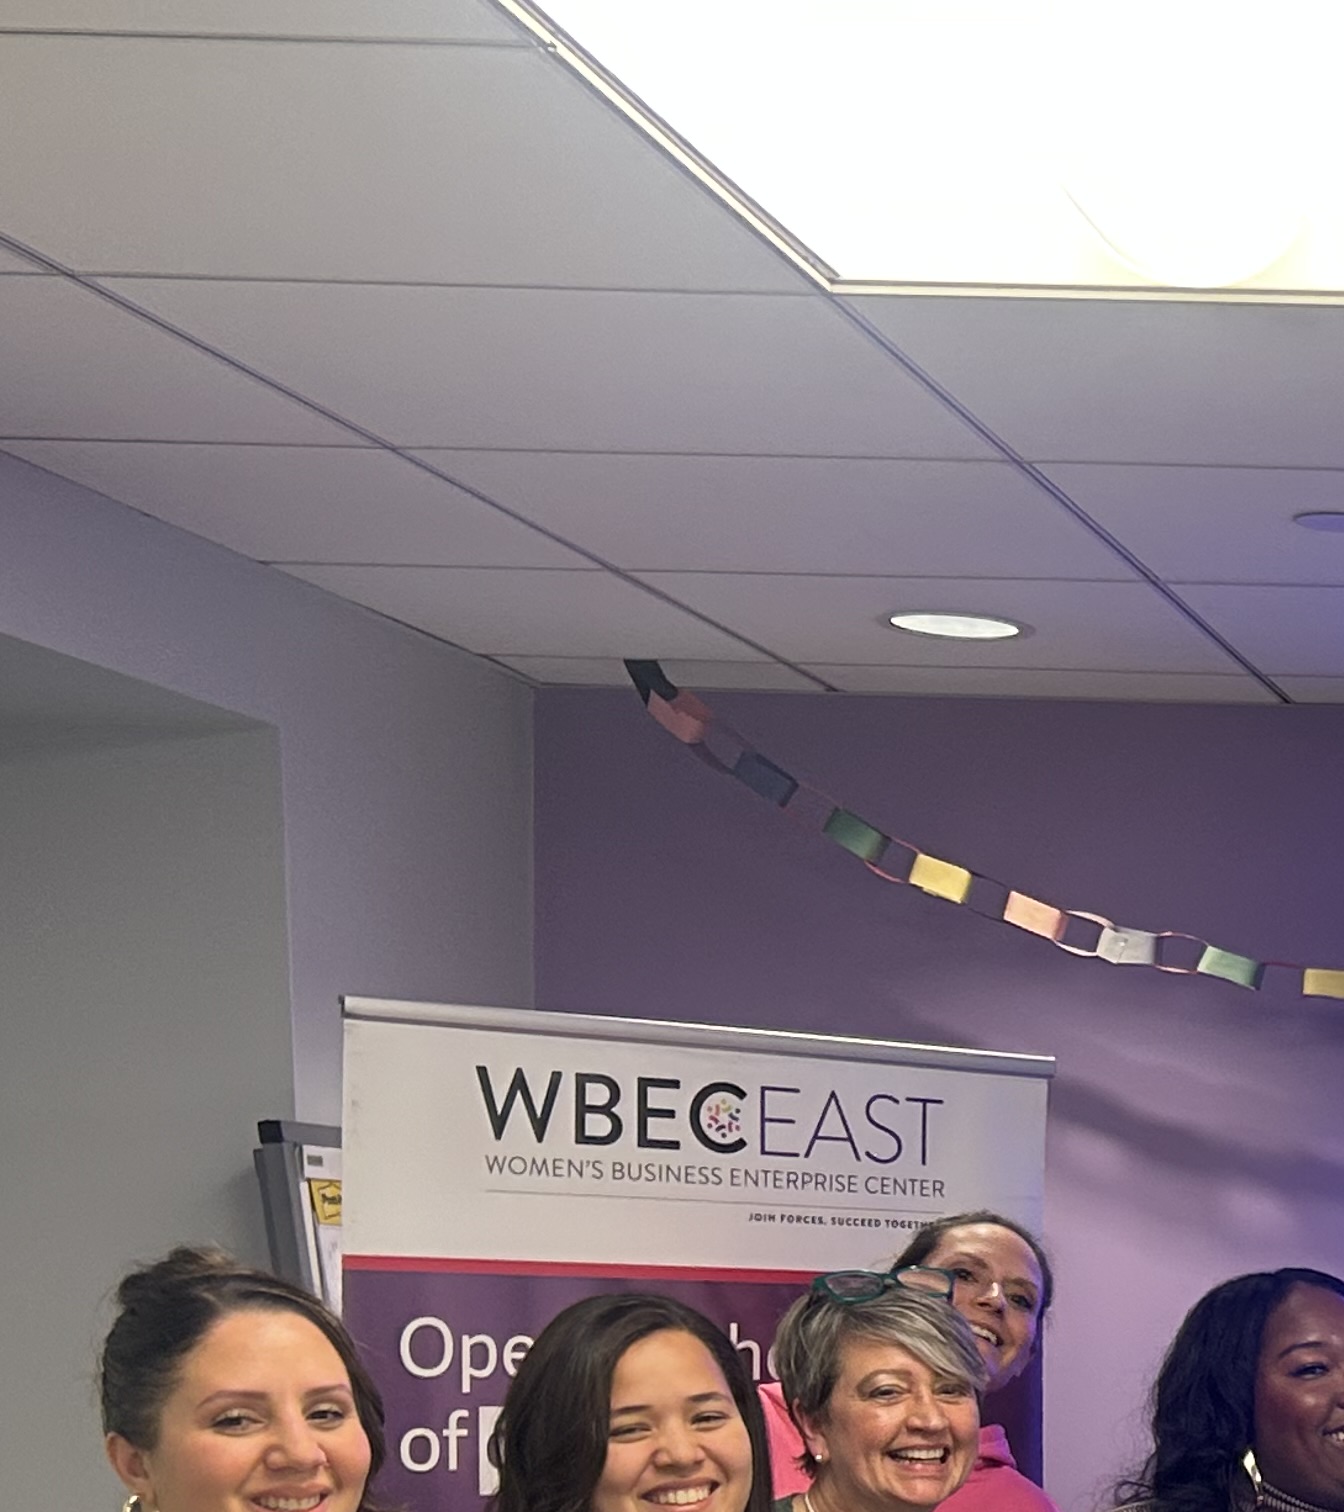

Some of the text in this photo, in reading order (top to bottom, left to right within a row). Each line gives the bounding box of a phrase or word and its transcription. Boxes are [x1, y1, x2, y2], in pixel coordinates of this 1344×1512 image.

[484, 1154, 946, 1198] WOMEN'S BUSINESS ENTERPRISE CENTER
[748, 1213, 776, 1223] JOIN
[831, 1217, 881, 1228] SUCCEED
[400, 1408, 469, 1472] of
